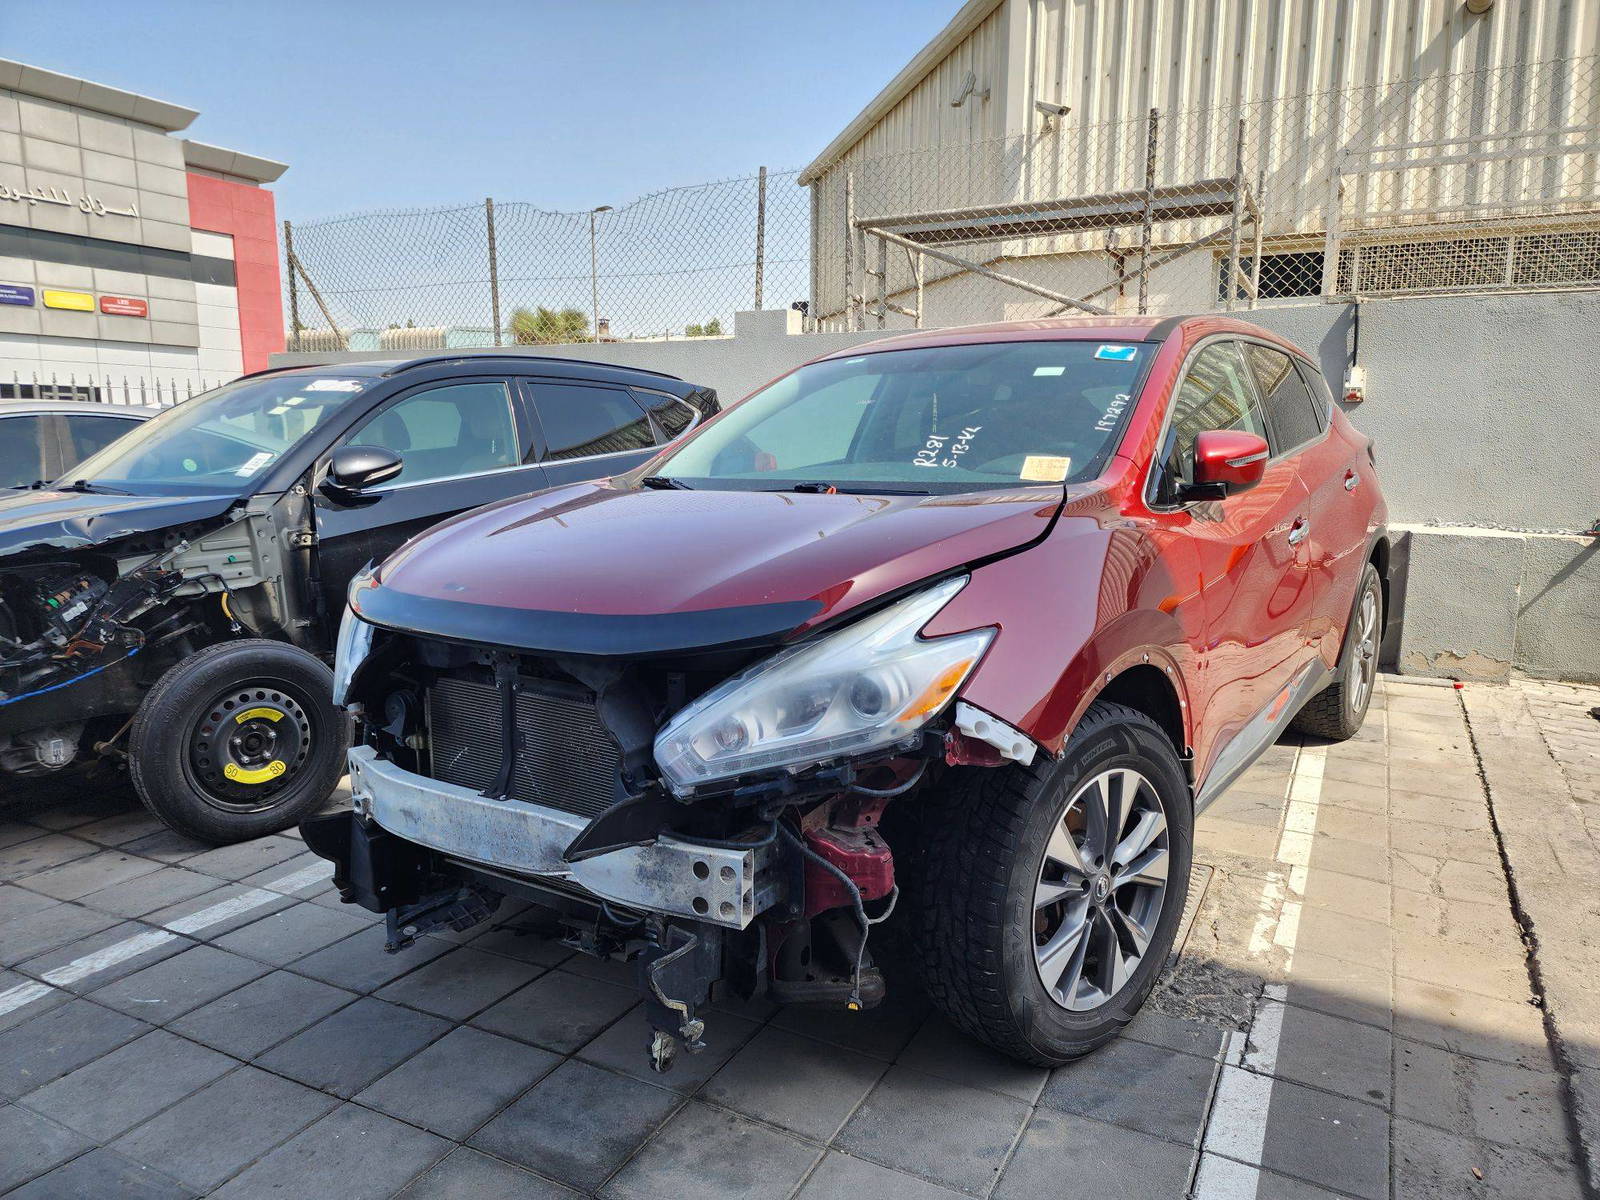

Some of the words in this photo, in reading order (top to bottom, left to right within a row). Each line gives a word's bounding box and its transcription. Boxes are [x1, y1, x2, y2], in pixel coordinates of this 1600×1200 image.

[1094, 393, 1131, 432] 197292
[912, 435, 950, 467] R281
[1082, 739, 1114, 765] WINTER
